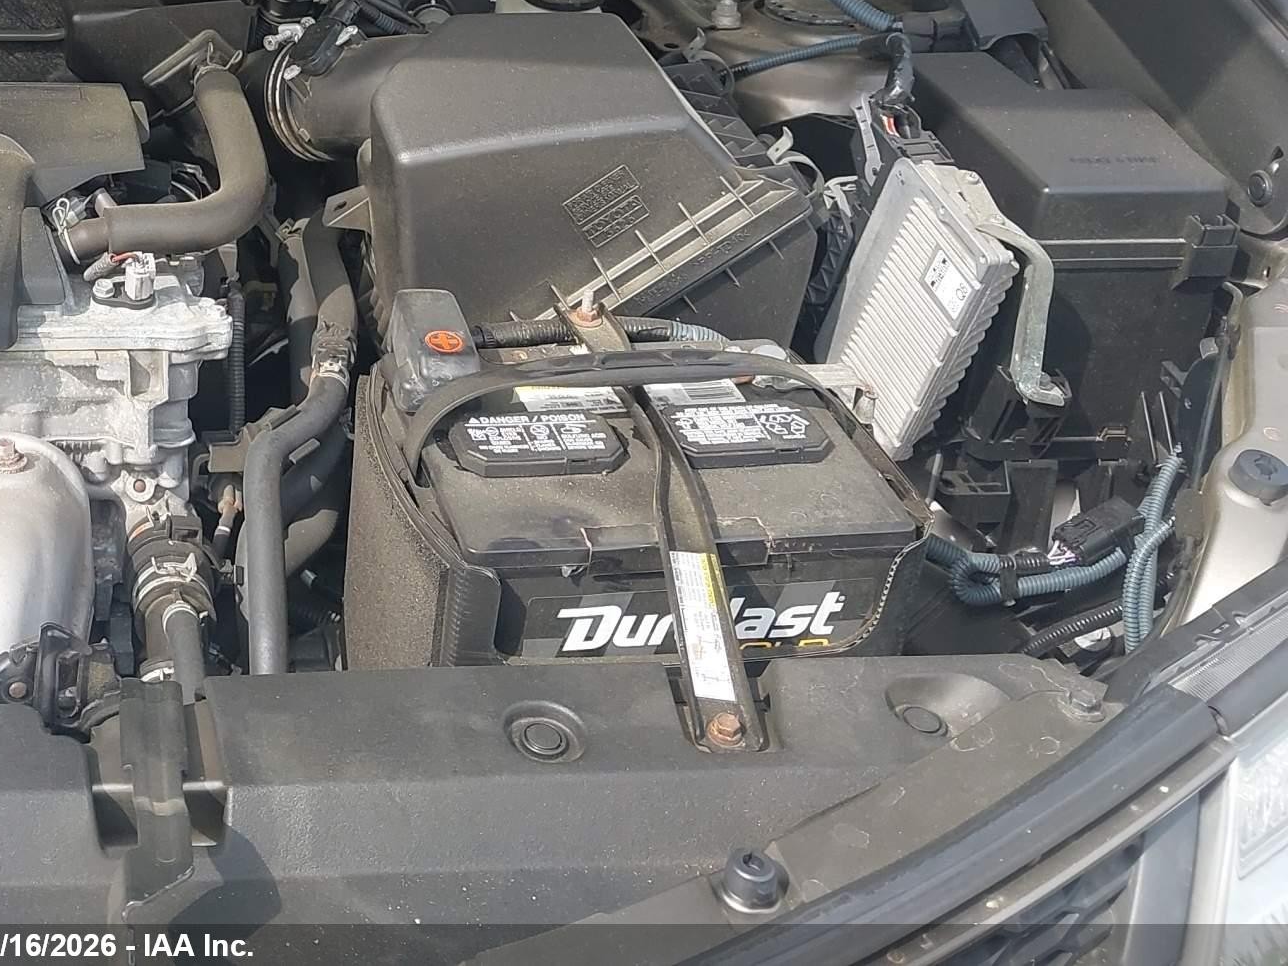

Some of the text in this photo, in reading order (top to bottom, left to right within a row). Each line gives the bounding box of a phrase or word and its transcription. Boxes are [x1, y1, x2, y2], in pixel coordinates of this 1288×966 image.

[479, 415, 530, 424] DANGER
[540, 414, 587, 423] POISON
[556, 591, 845, 652] Durlast
